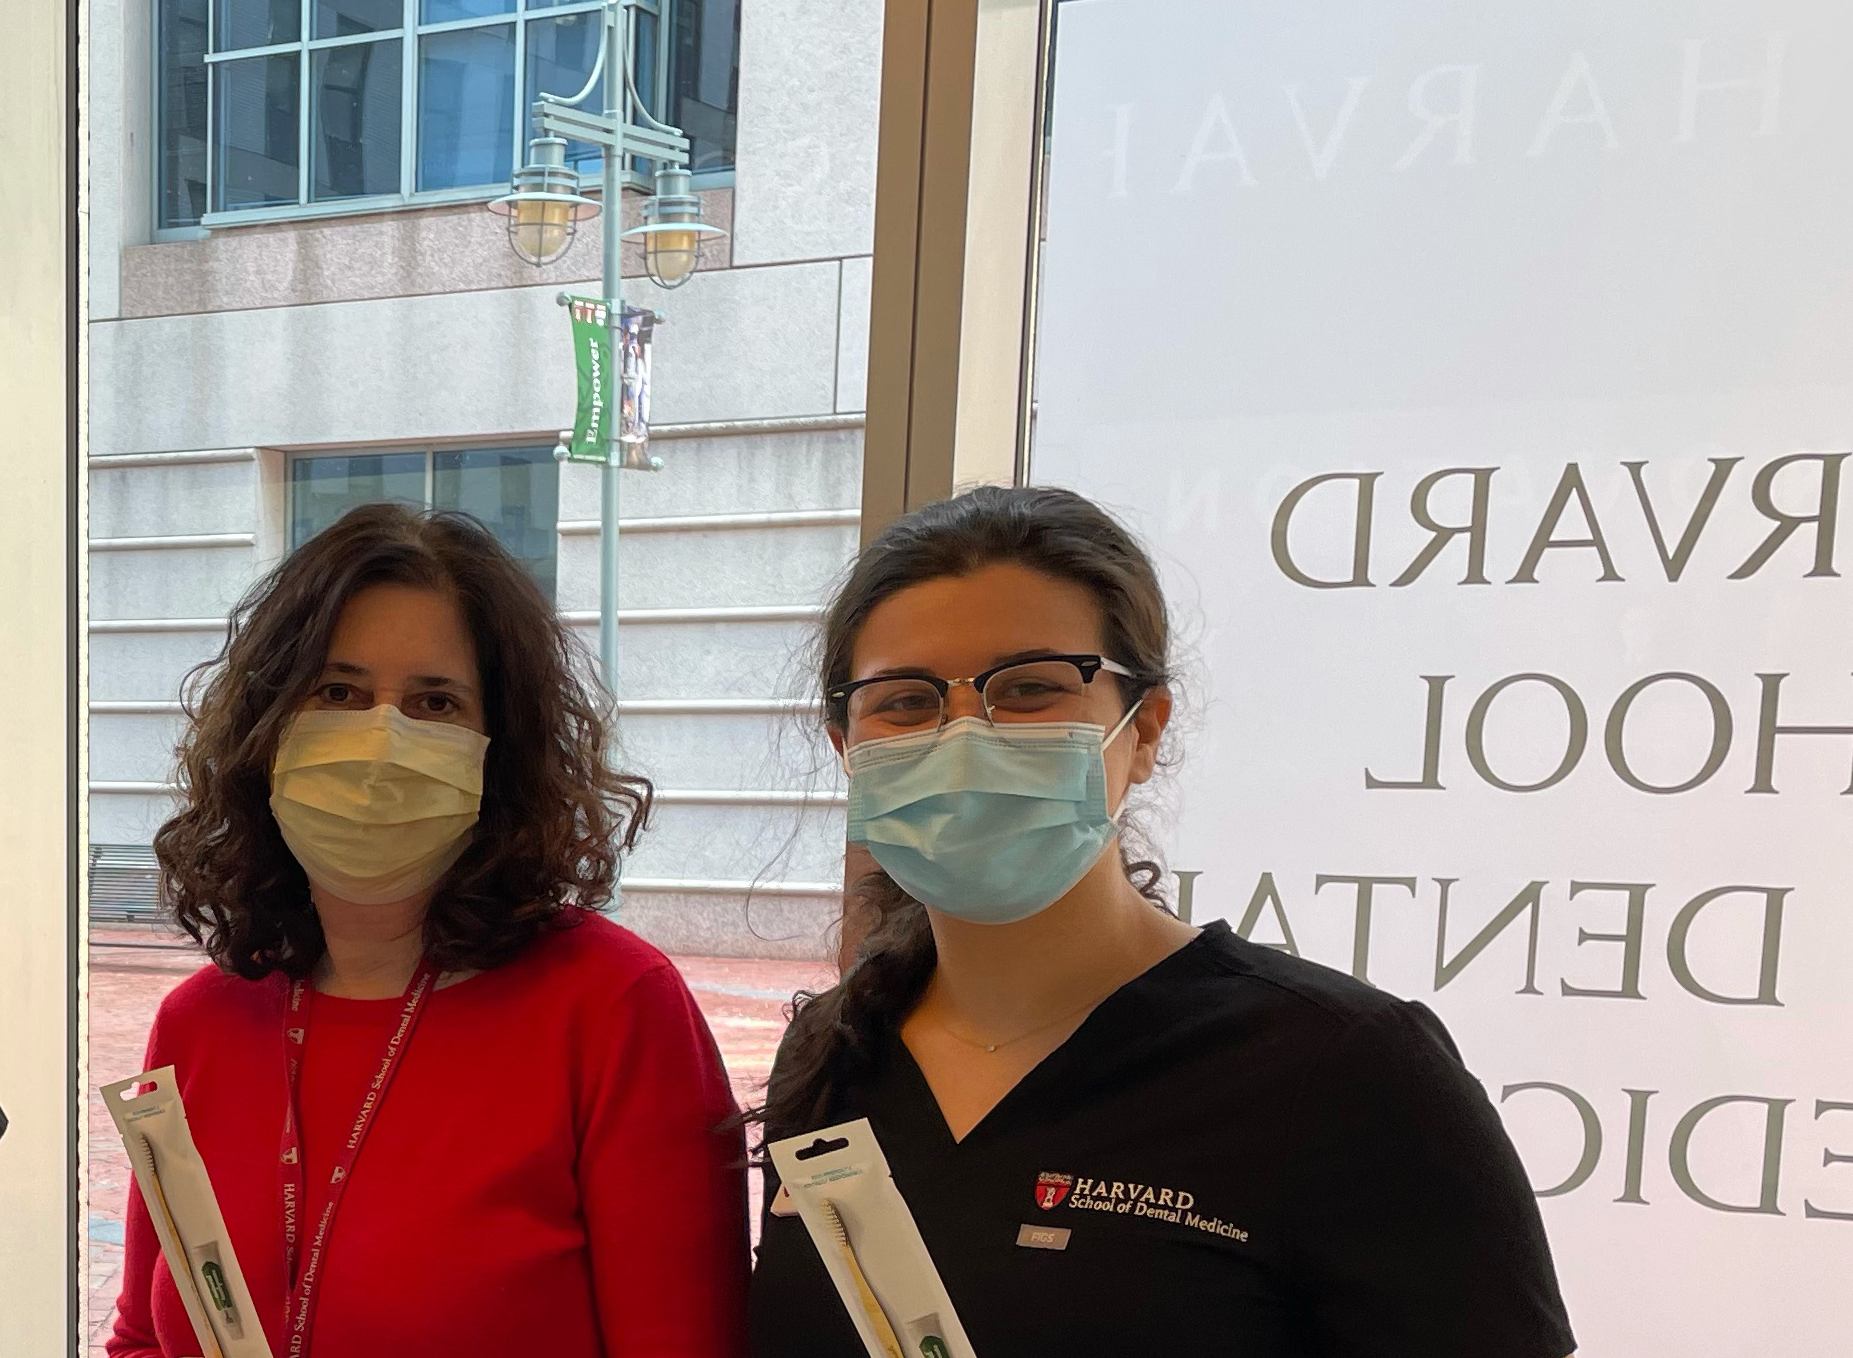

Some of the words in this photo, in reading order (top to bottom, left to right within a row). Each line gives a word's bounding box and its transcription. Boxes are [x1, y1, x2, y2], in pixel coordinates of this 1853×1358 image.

[586, 338, 603, 444] Empower
[403, 972, 431, 1013] Medicine
[390, 1014, 412, 1045] Dental
[388, 1046, 397, 1057] of
[371, 1057, 392, 1090] School
[346, 1091, 377, 1149] HARVARD
[1073, 1178, 1195, 1210] HARVARD
[283, 1183, 296, 1244] HARVARD
[314, 1201, 334, 1246] Medicine
[1068, 1194, 1116, 1212] School
[1116, 1200, 1133, 1214] of
[1133, 1203, 1182, 1224] Dental
[1184, 1212, 1249, 1242] Medicine
[305, 1248, 321, 1282] Dental
[304, 1282, 313, 1295] of
[294, 1295, 310, 1332] School
